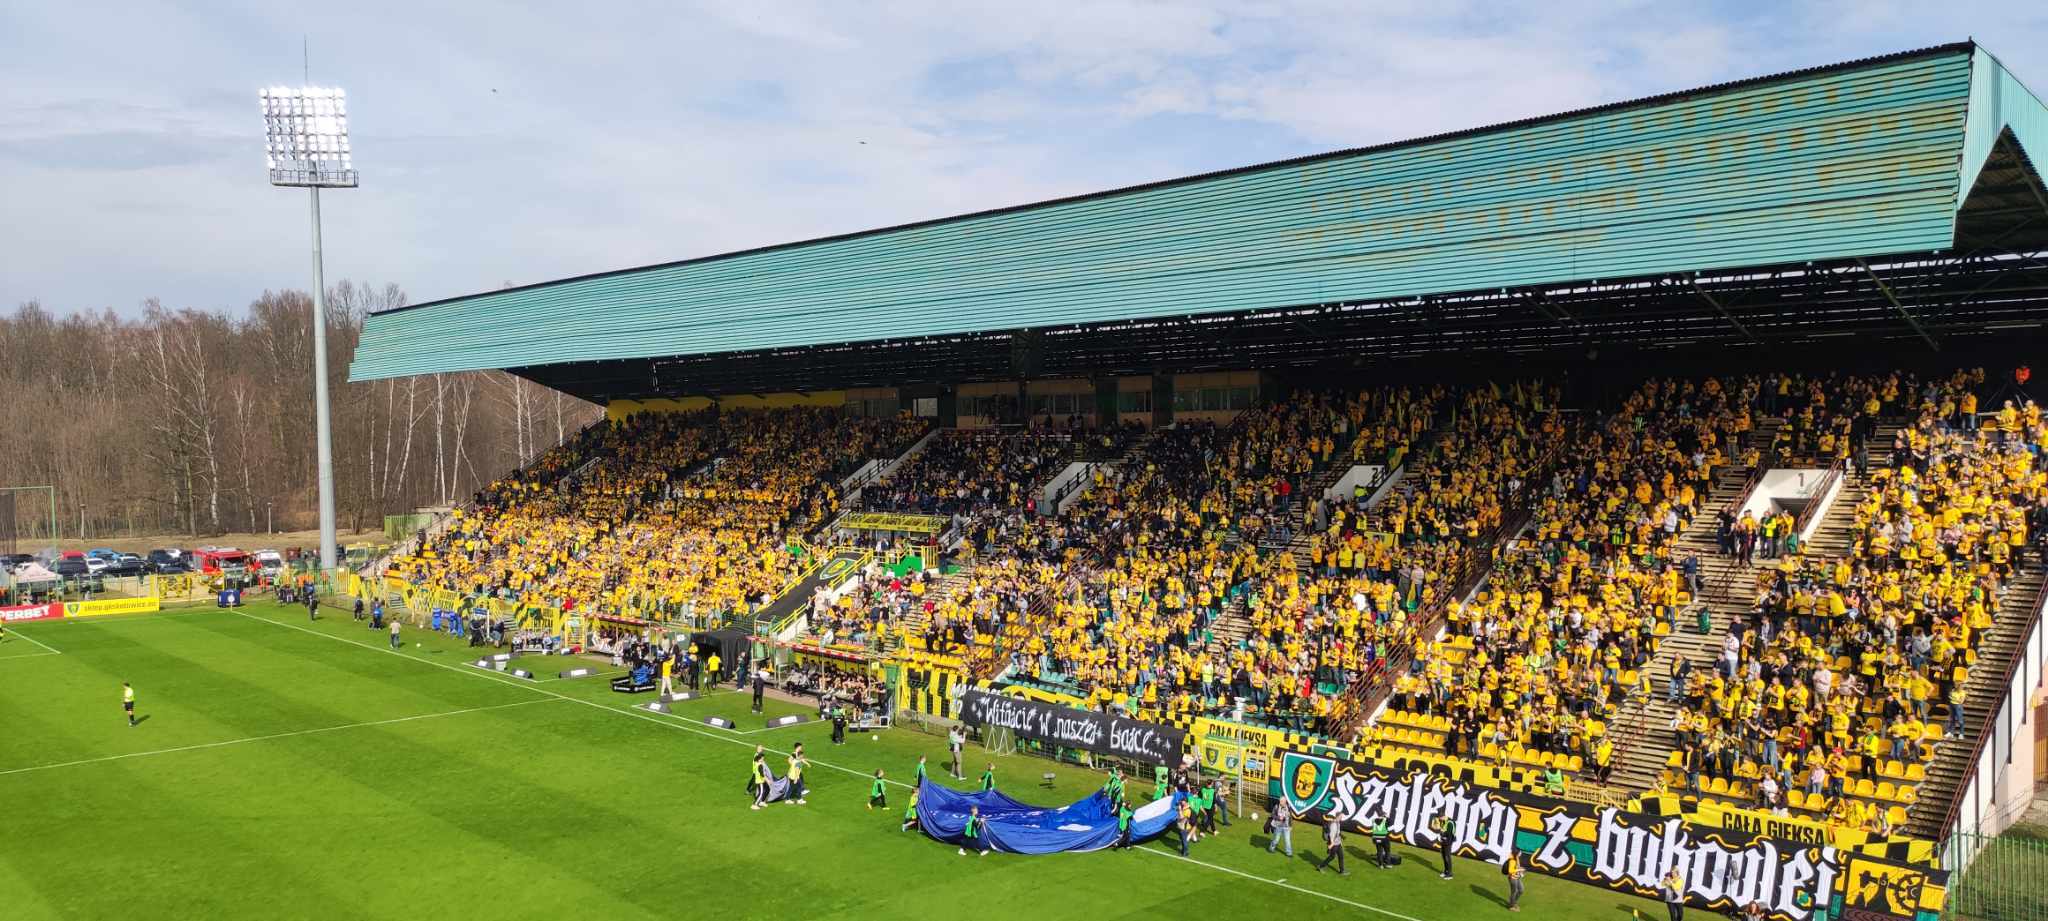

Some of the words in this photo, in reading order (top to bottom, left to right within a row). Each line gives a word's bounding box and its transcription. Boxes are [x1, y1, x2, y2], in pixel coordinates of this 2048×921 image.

[1798, 472, 1804, 487] 1
[1053, 717, 1099, 744] naszej
[1722, 812, 1762, 834] CAŁA
[1767, 820, 1825, 847] GIEKSA
